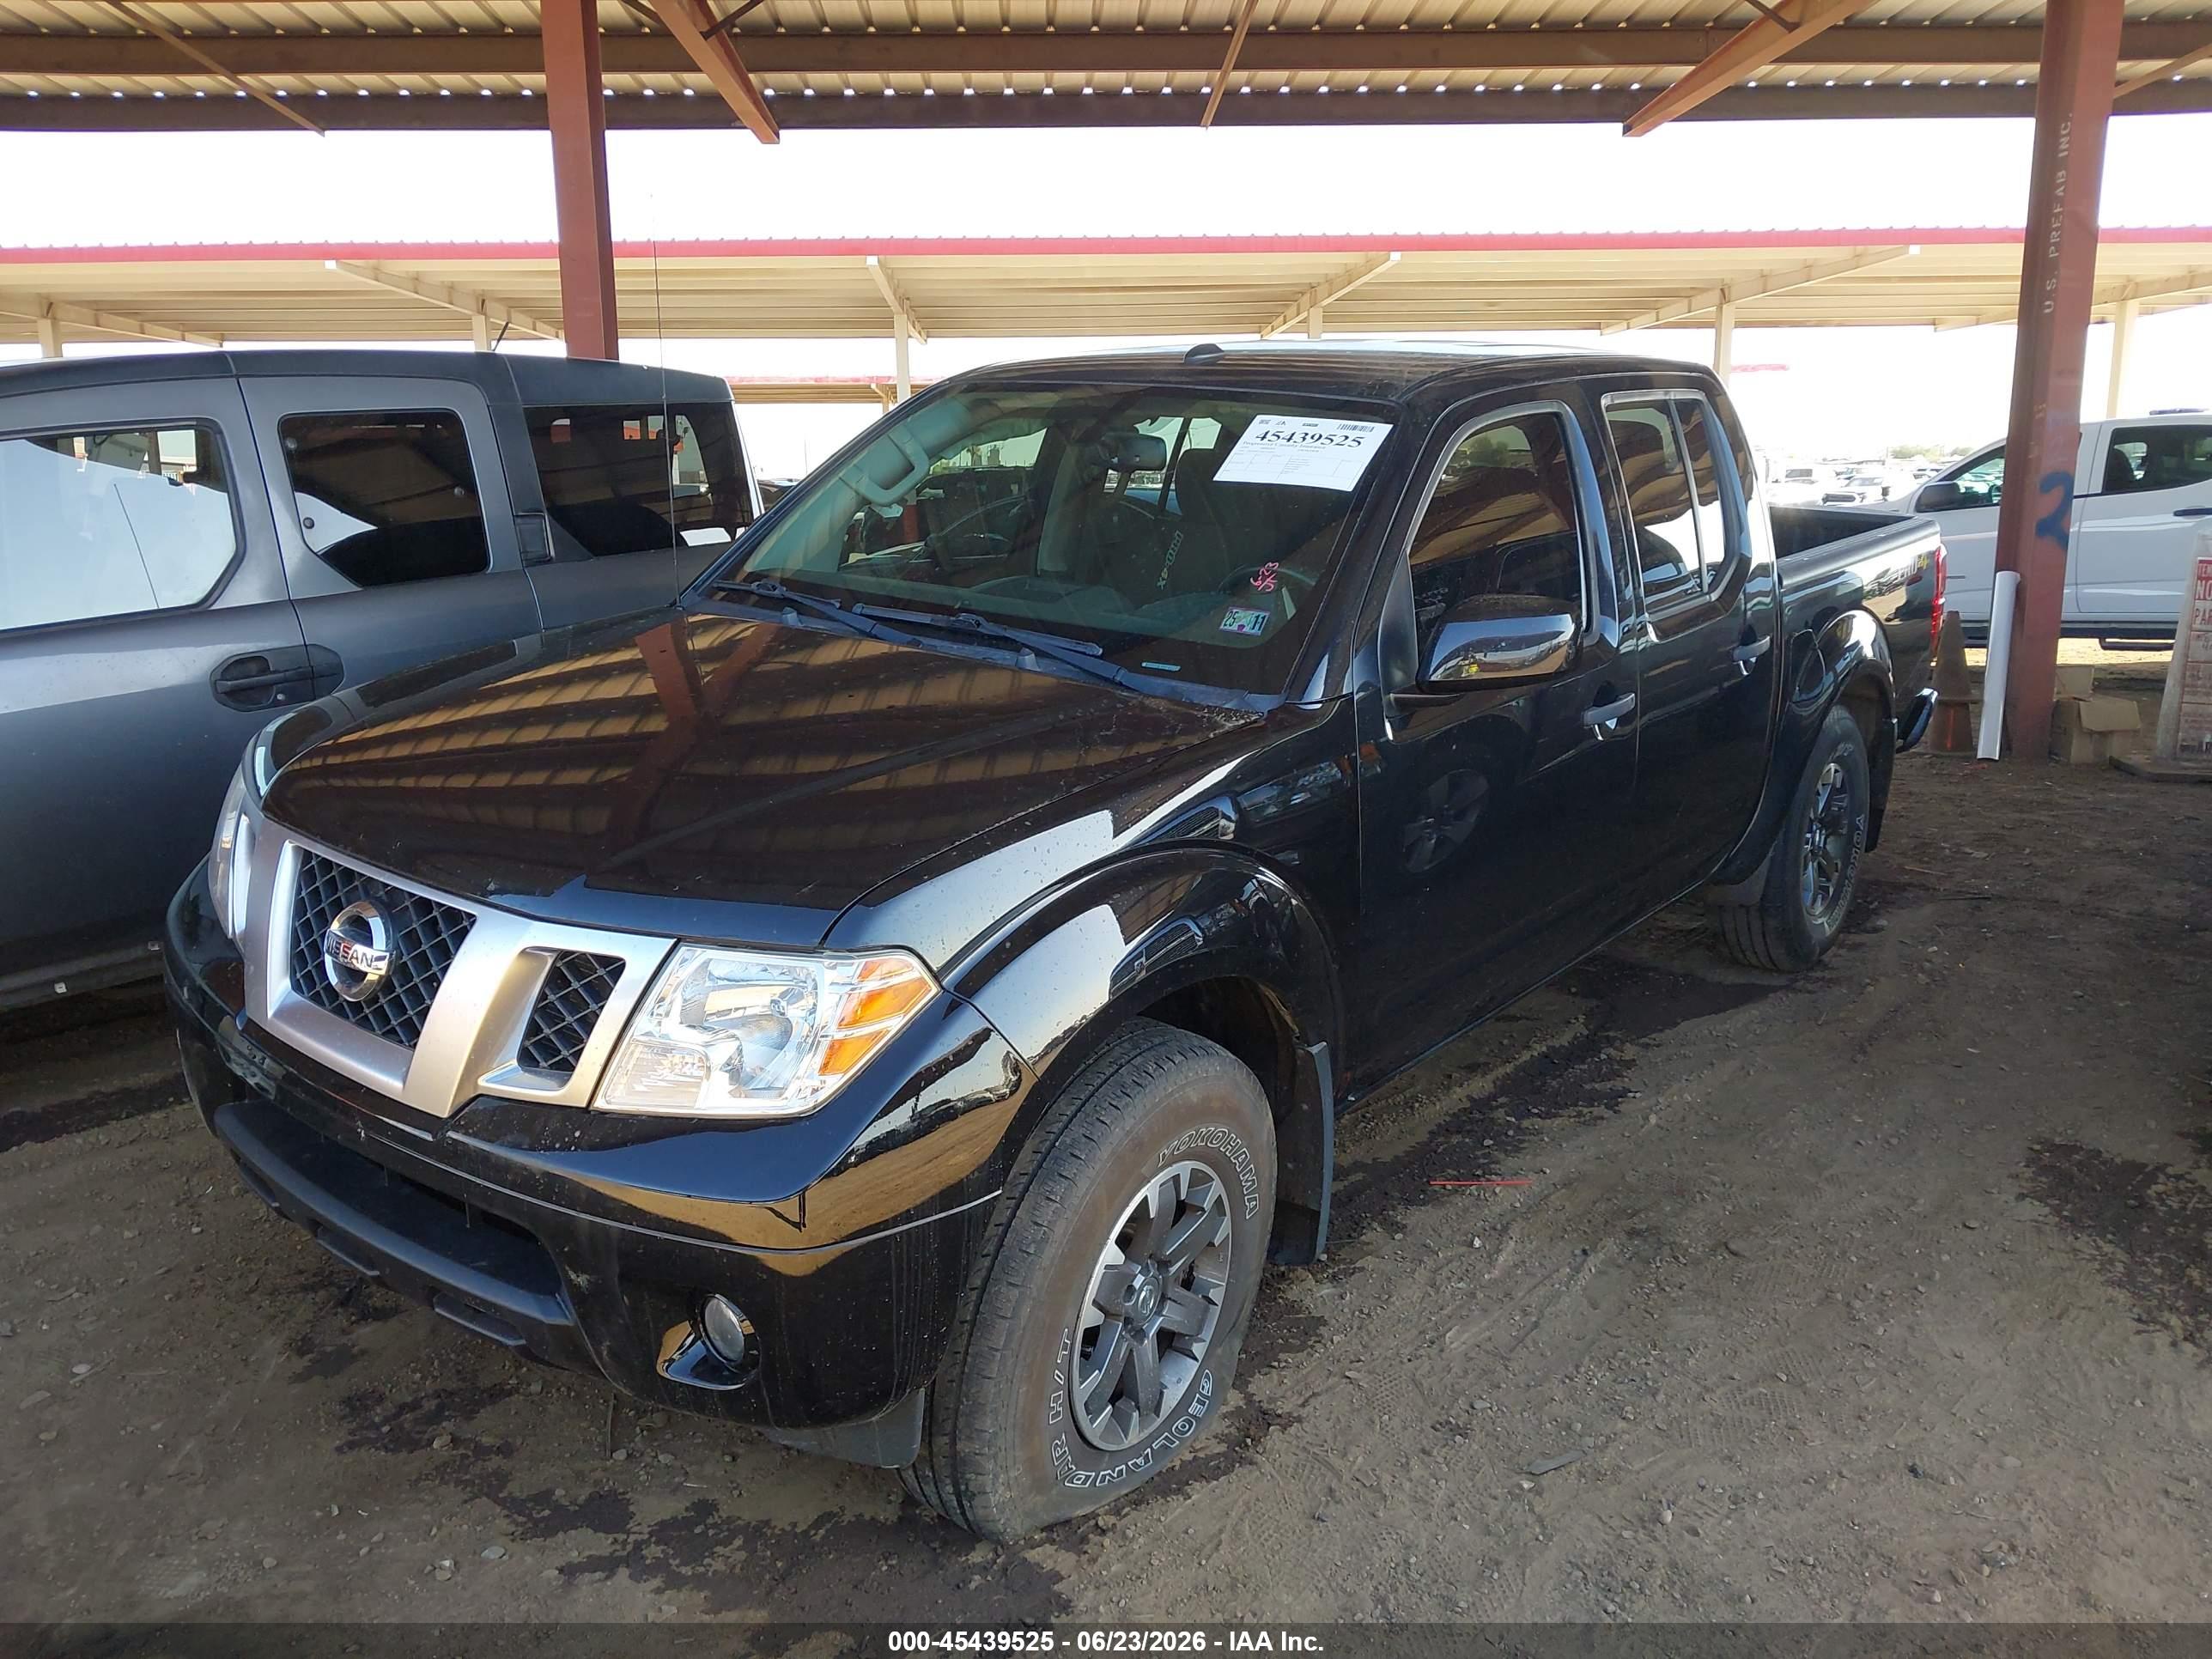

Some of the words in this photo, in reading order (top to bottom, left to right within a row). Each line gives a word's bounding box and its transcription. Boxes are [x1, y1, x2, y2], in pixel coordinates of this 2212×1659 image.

[2058, 112, 2073, 157] INC.
[2049, 170, 2067, 258] PREFAB
[2044, 270, 2057, 313] U.S.
[1255, 429, 1366, 448] 45439525
[2035, 470, 2075, 550] 2
[1249, 562, 1279, 586] 6-23
[1223, 611, 1239, 627] 25
[1251, 614, 1267, 631] 11
[326, 935, 374, 969] NISSAN
[1158, 1127, 1260, 1219] YOKOHAMA
[1050, 1369, 1213, 1489] GEOLANDAR
